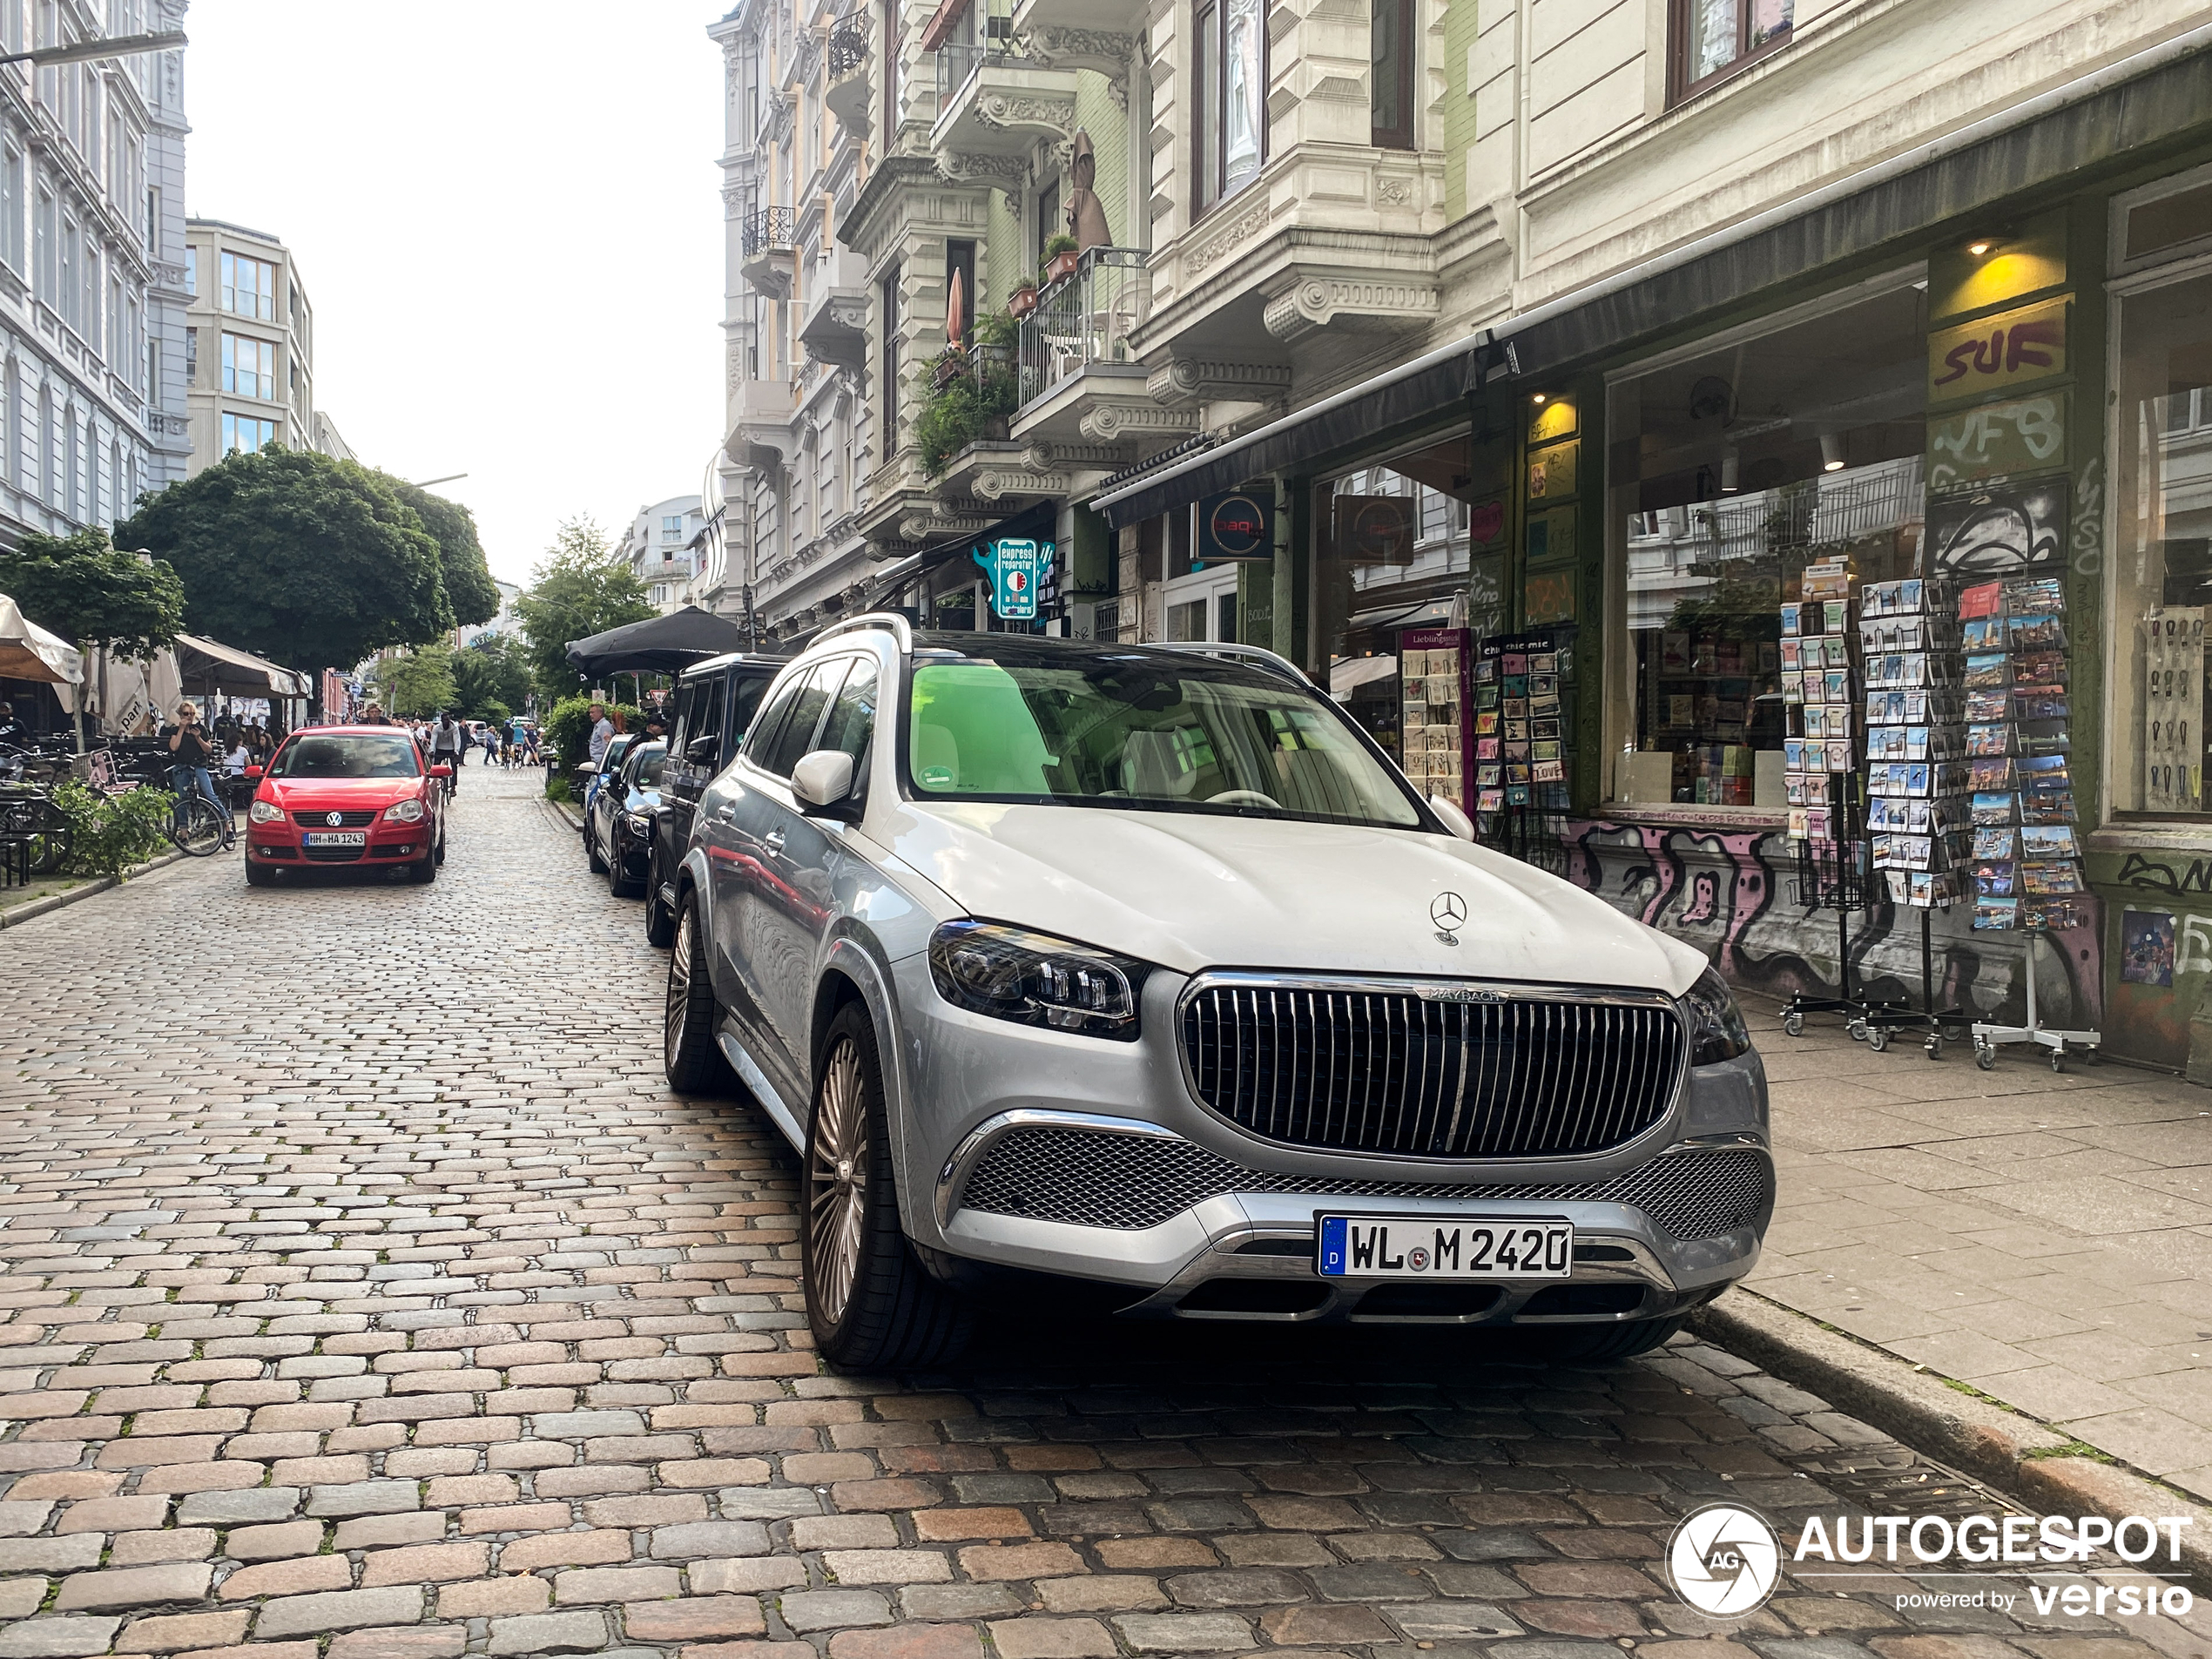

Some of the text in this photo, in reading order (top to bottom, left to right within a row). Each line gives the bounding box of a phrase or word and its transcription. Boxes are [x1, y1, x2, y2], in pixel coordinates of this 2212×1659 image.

[1001, 548, 1033, 560] express
[1001, 559, 1033, 570] reparatur
[121, 699, 144, 731] park
[310, 833, 363, 844] HH HA 1243
[1428, 988, 1500, 1001] MAYBACH
[1329, 1226, 1568, 1271] D WL M 2420
